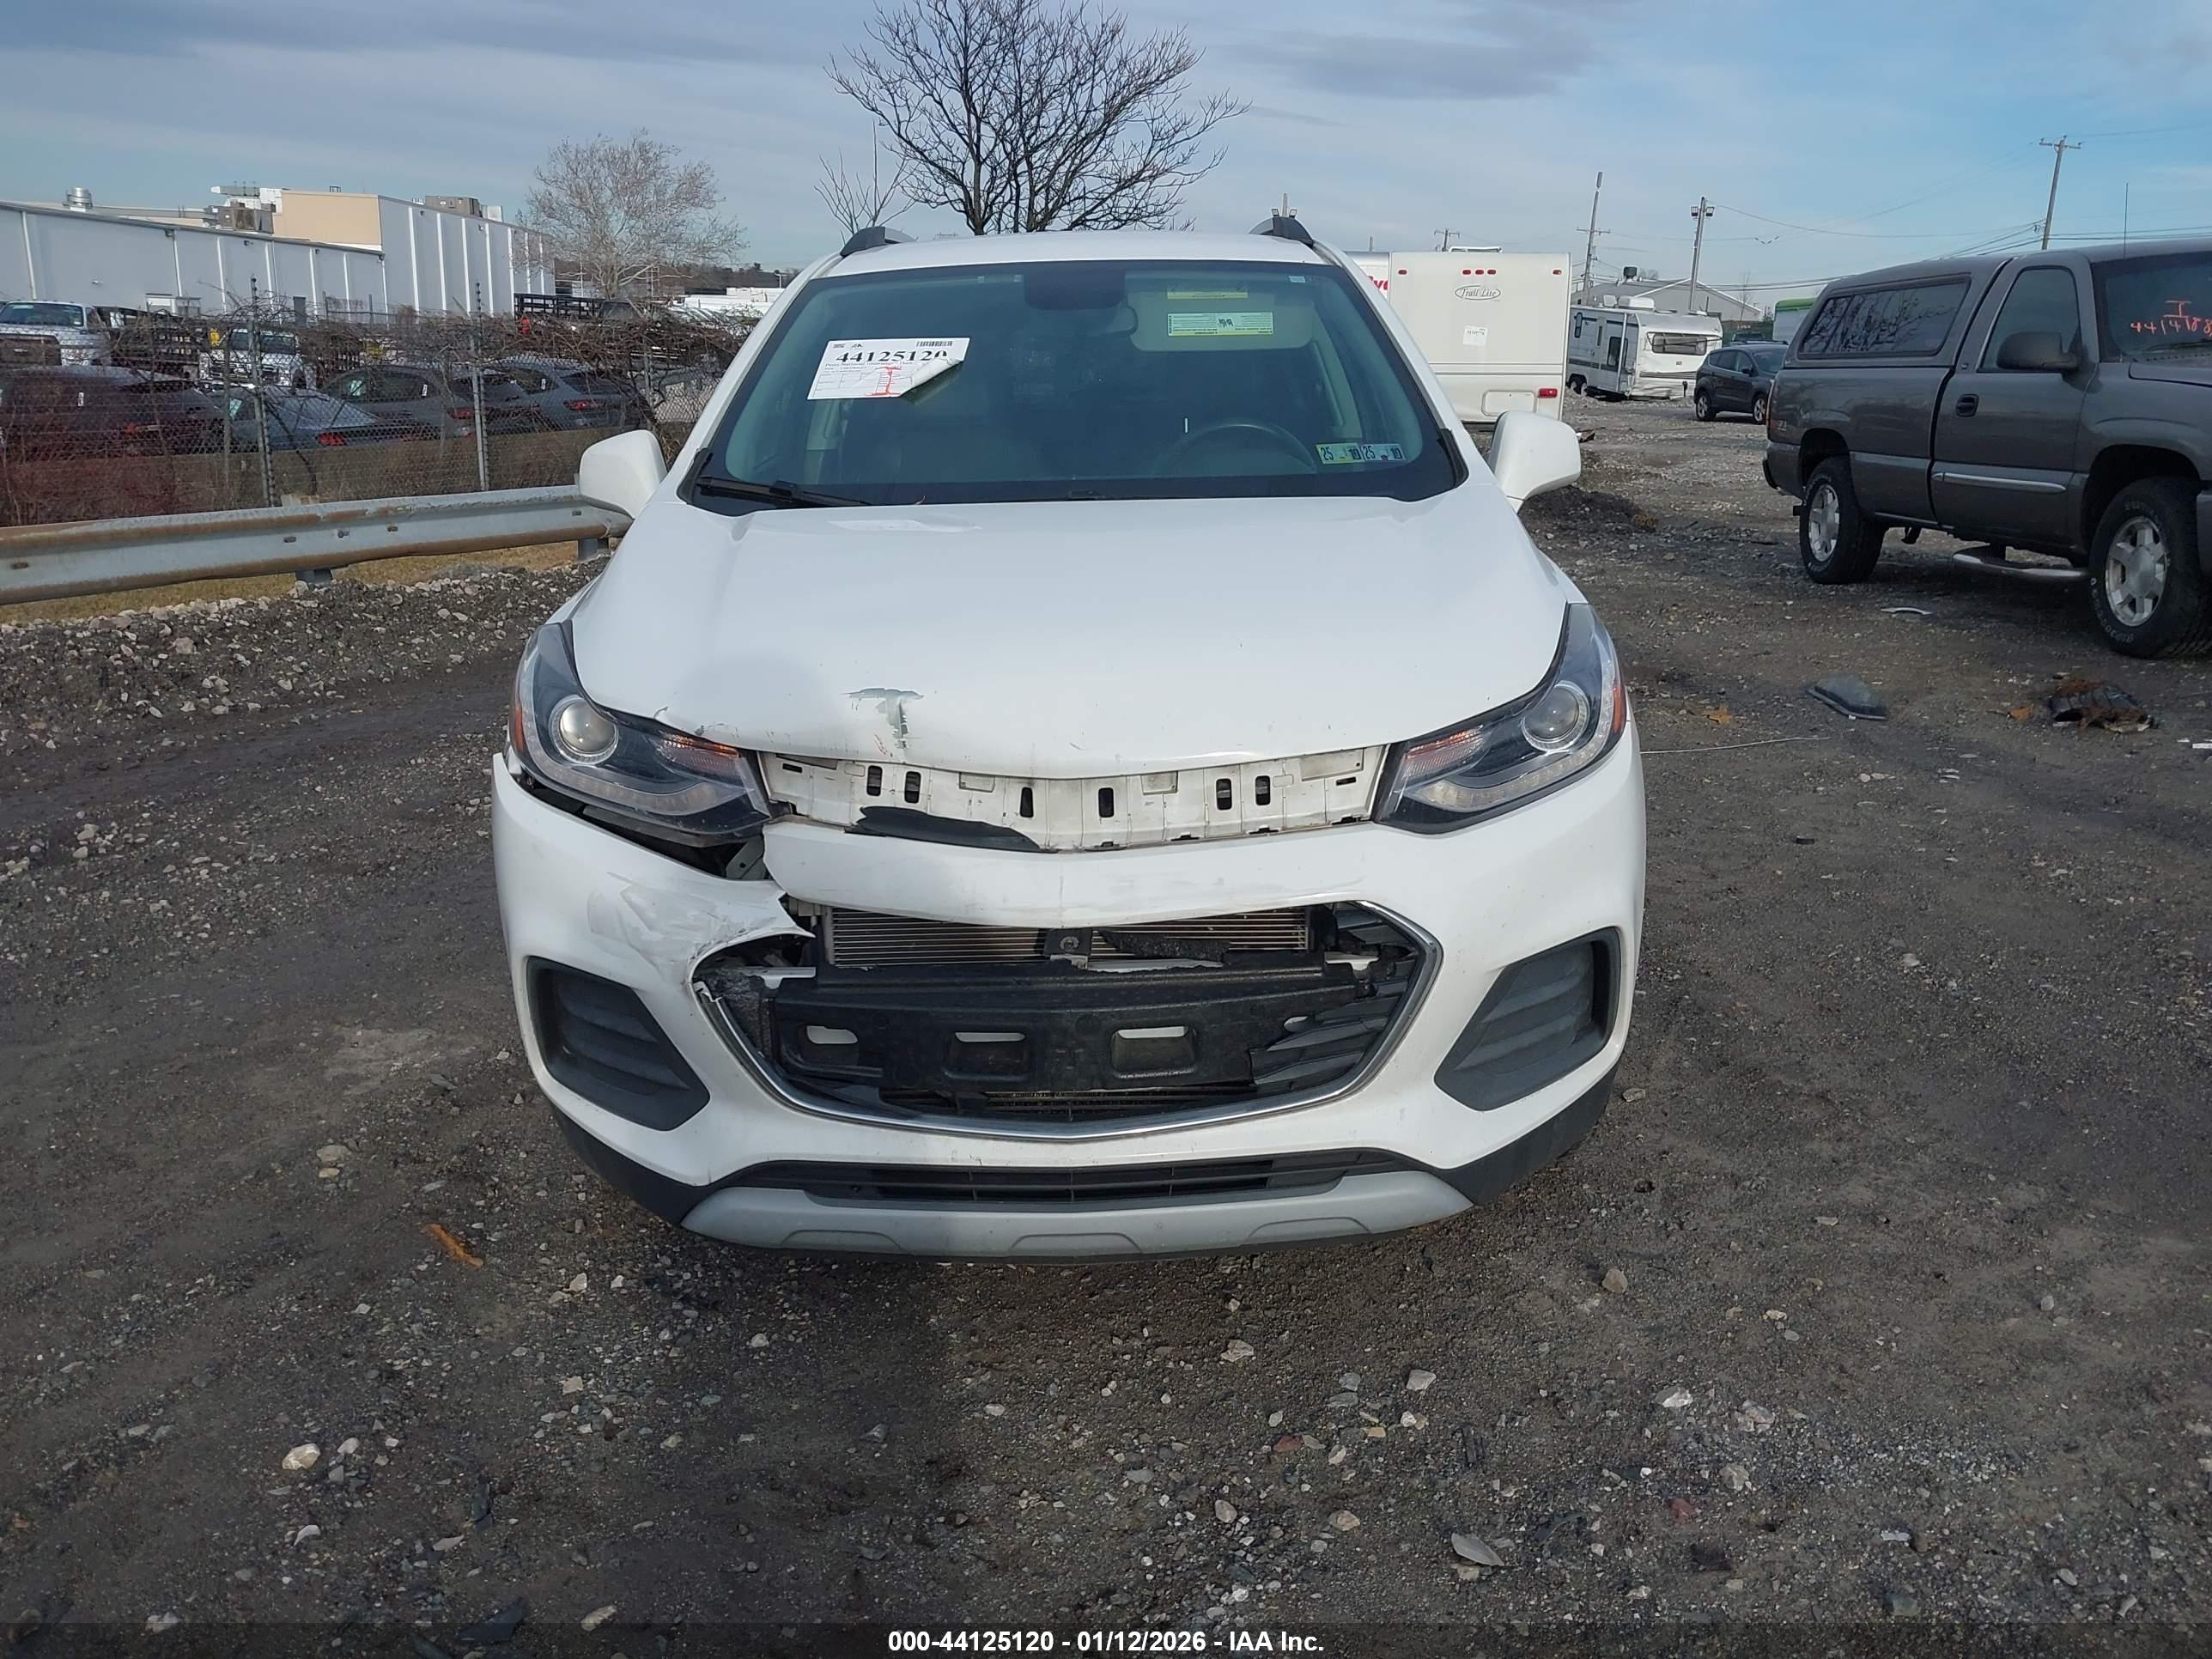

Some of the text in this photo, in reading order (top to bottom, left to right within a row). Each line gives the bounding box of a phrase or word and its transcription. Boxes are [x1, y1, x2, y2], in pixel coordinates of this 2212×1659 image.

[1460, 288, 1497, 297] Trail Lite
[1320, 447, 1334, 461] 25
[1362, 446, 1376, 460] 25
